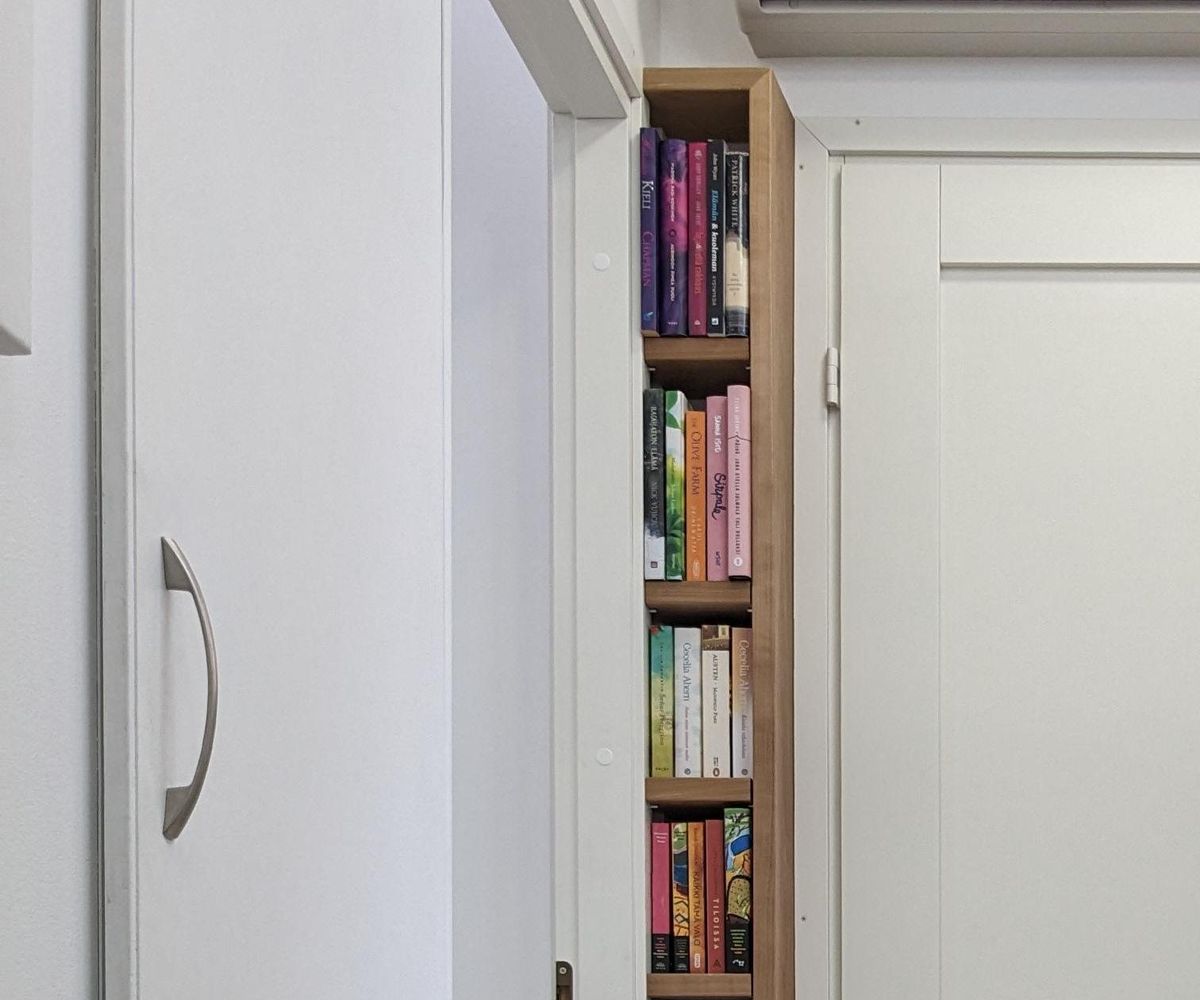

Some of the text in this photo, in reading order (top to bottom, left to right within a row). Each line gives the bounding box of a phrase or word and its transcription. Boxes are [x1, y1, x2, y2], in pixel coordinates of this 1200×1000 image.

[712, 190, 720, 221] Elämän
[691, 431, 702, 495] OLIVE FARM
[710, 473, 726, 520] Sirpale
[683, 642, 691, 673] Cecelia
[739, 640, 749, 677] Cecelia
[683, 676, 691, 702] Ahern
[693, 872, 701, 898] KAIKKI
